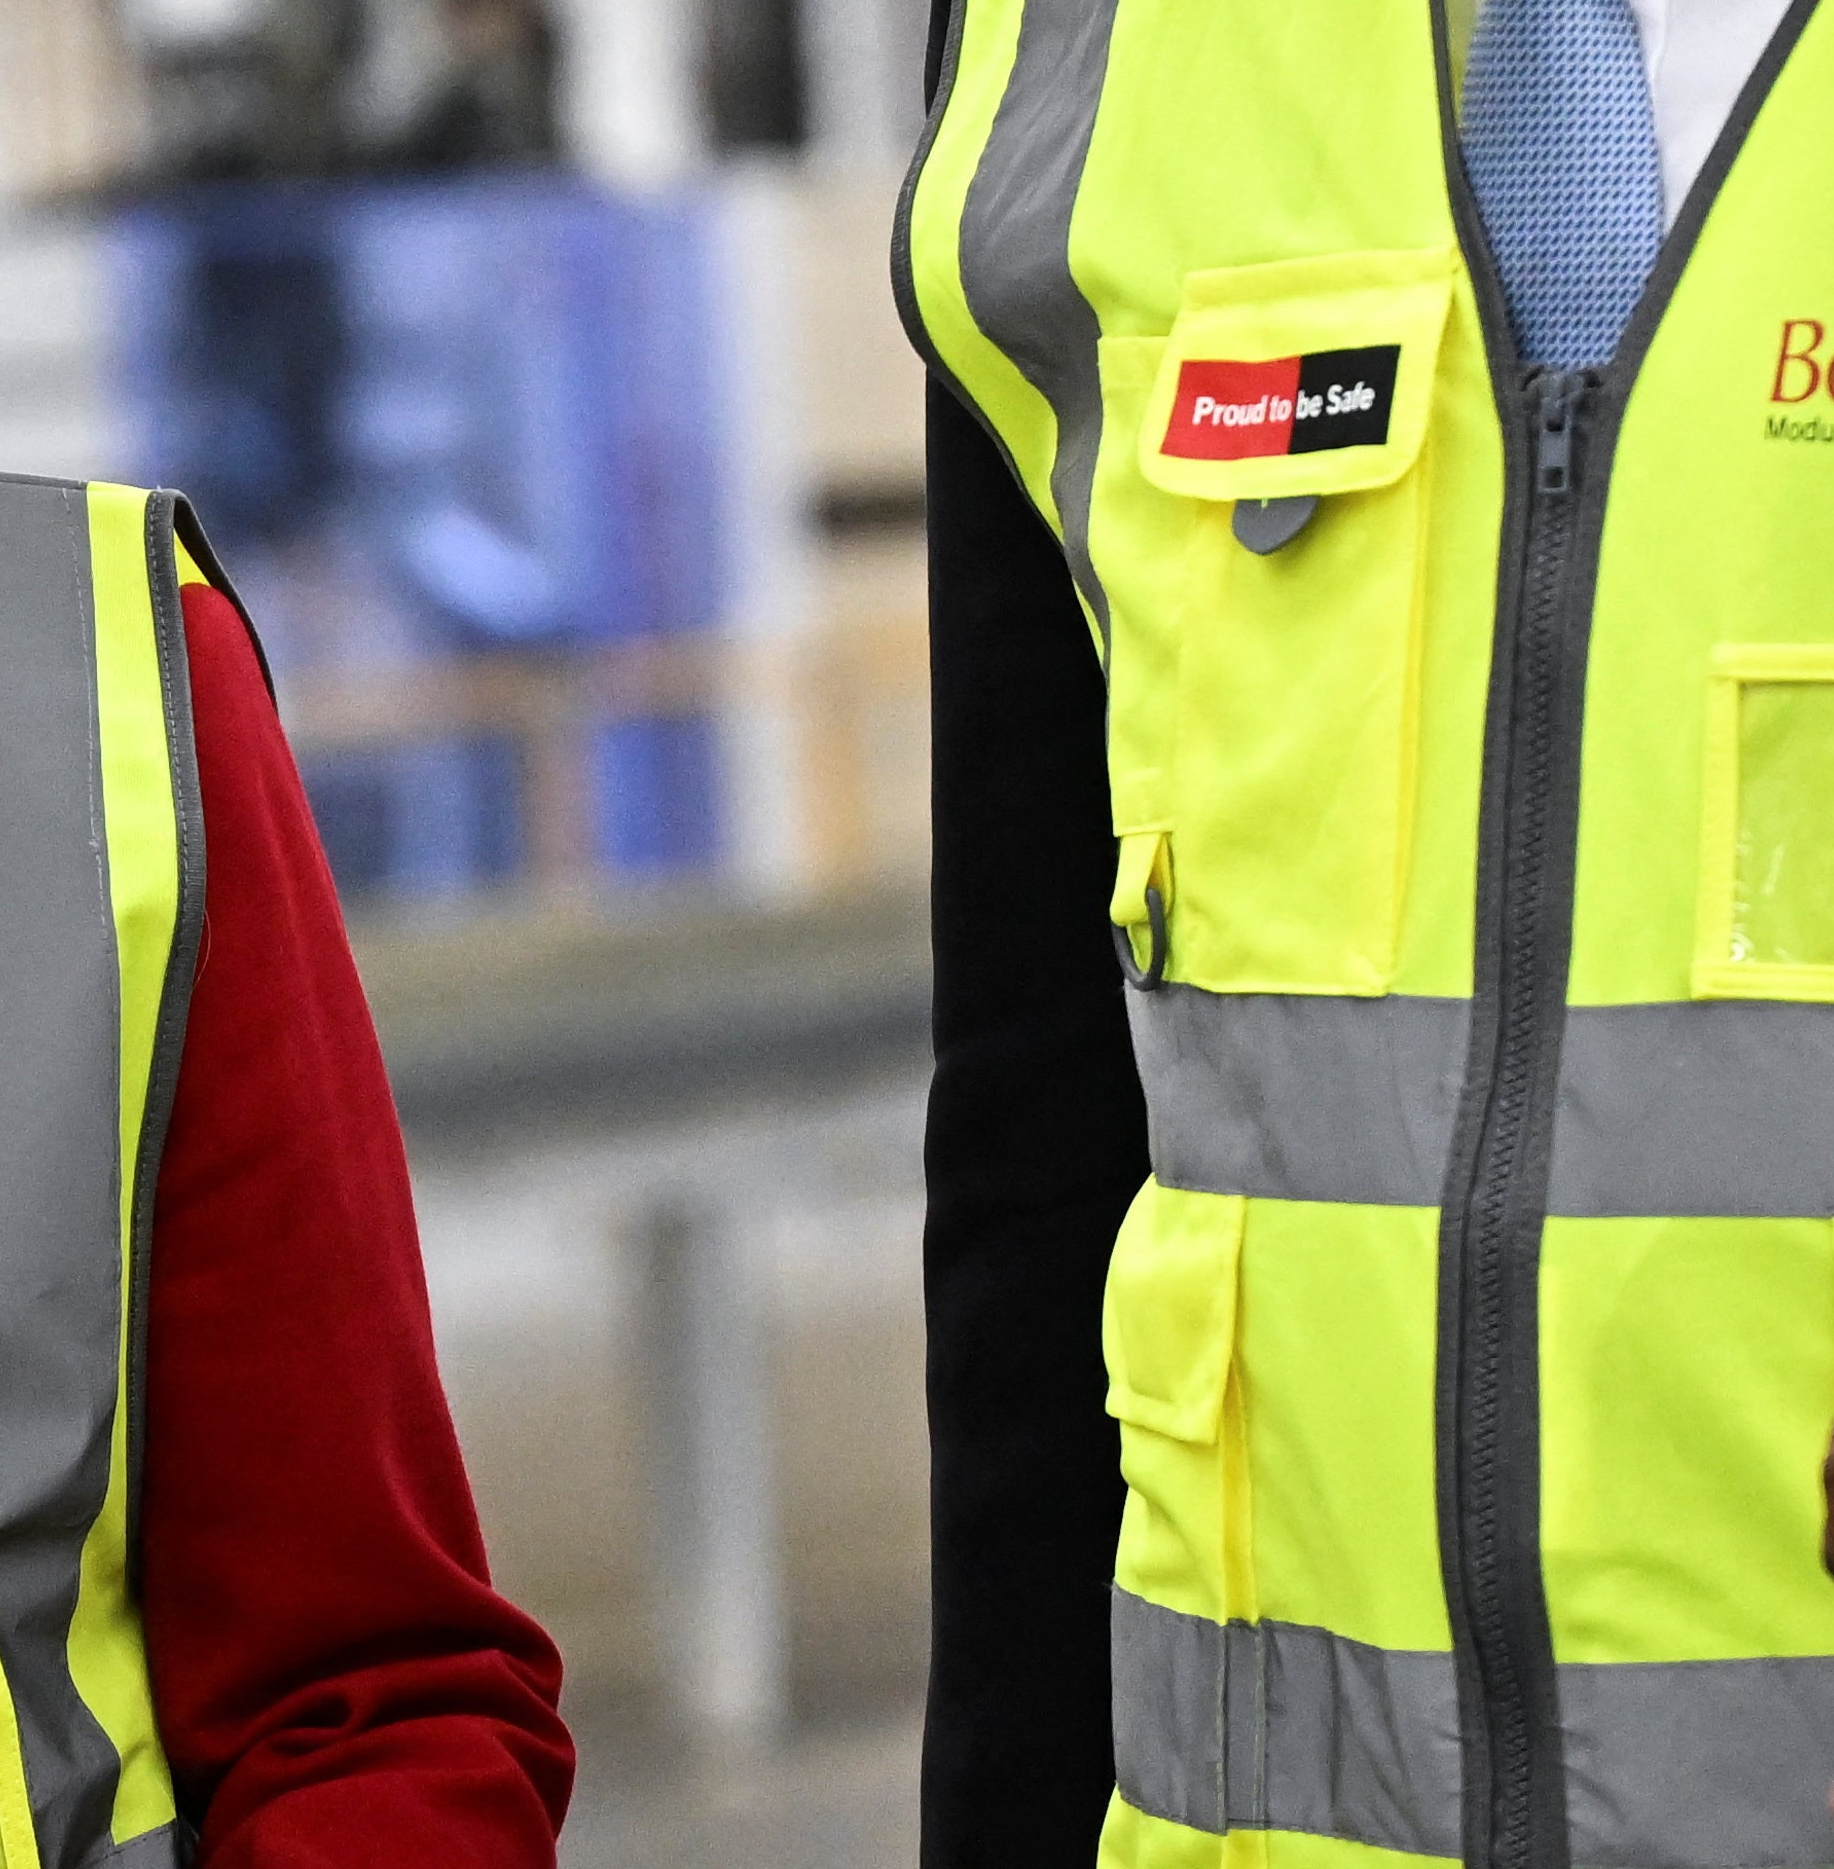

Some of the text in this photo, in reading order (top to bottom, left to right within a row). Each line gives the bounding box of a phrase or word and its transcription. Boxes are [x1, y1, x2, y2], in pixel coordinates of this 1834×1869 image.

[1191, 380, 1376, 427] Proud to be Safe
